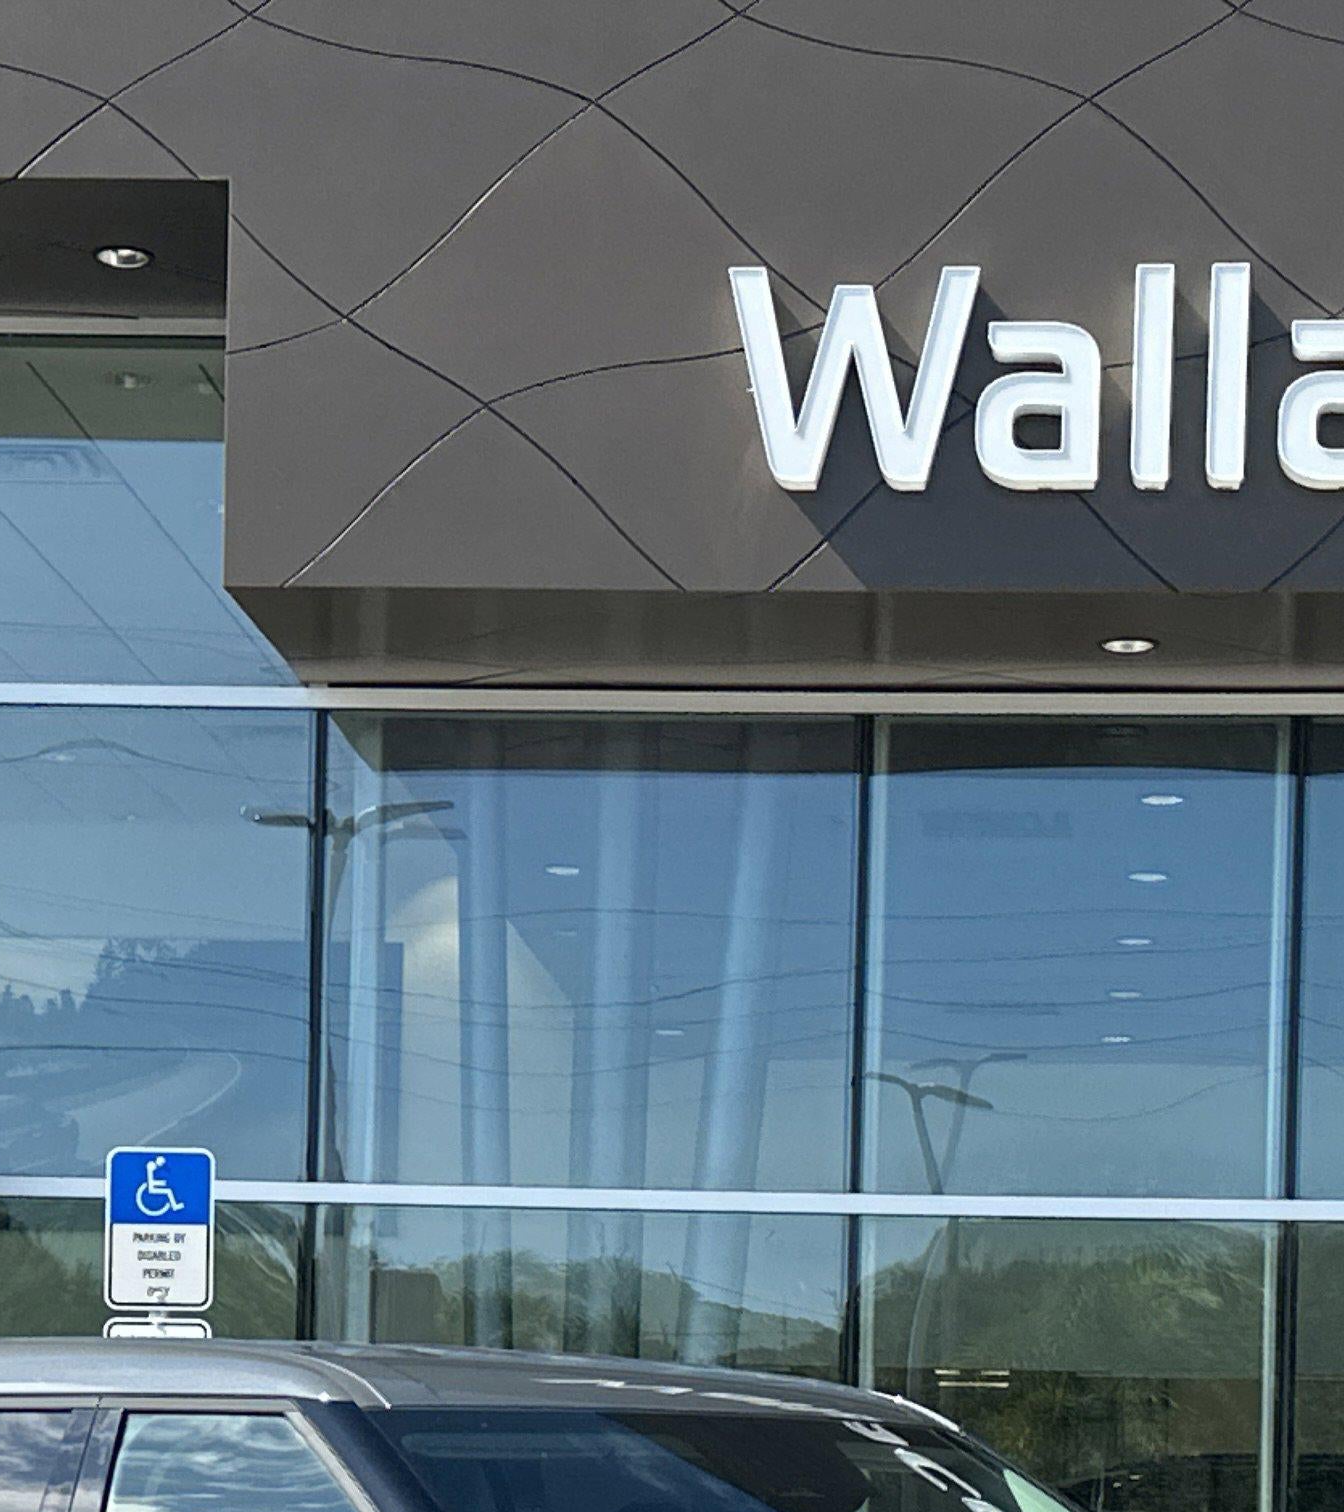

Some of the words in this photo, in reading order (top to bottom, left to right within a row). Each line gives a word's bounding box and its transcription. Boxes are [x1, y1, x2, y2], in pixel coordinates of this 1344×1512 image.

[133, 1232, 170, 1244] PARKING
[174, 1232, 186, 1244] BY
[137, 1250, 181, 1261] DISABLED
[142, 1268, 175, 1279] PERMIT
[147, 1286, 170, 1298] ONY
